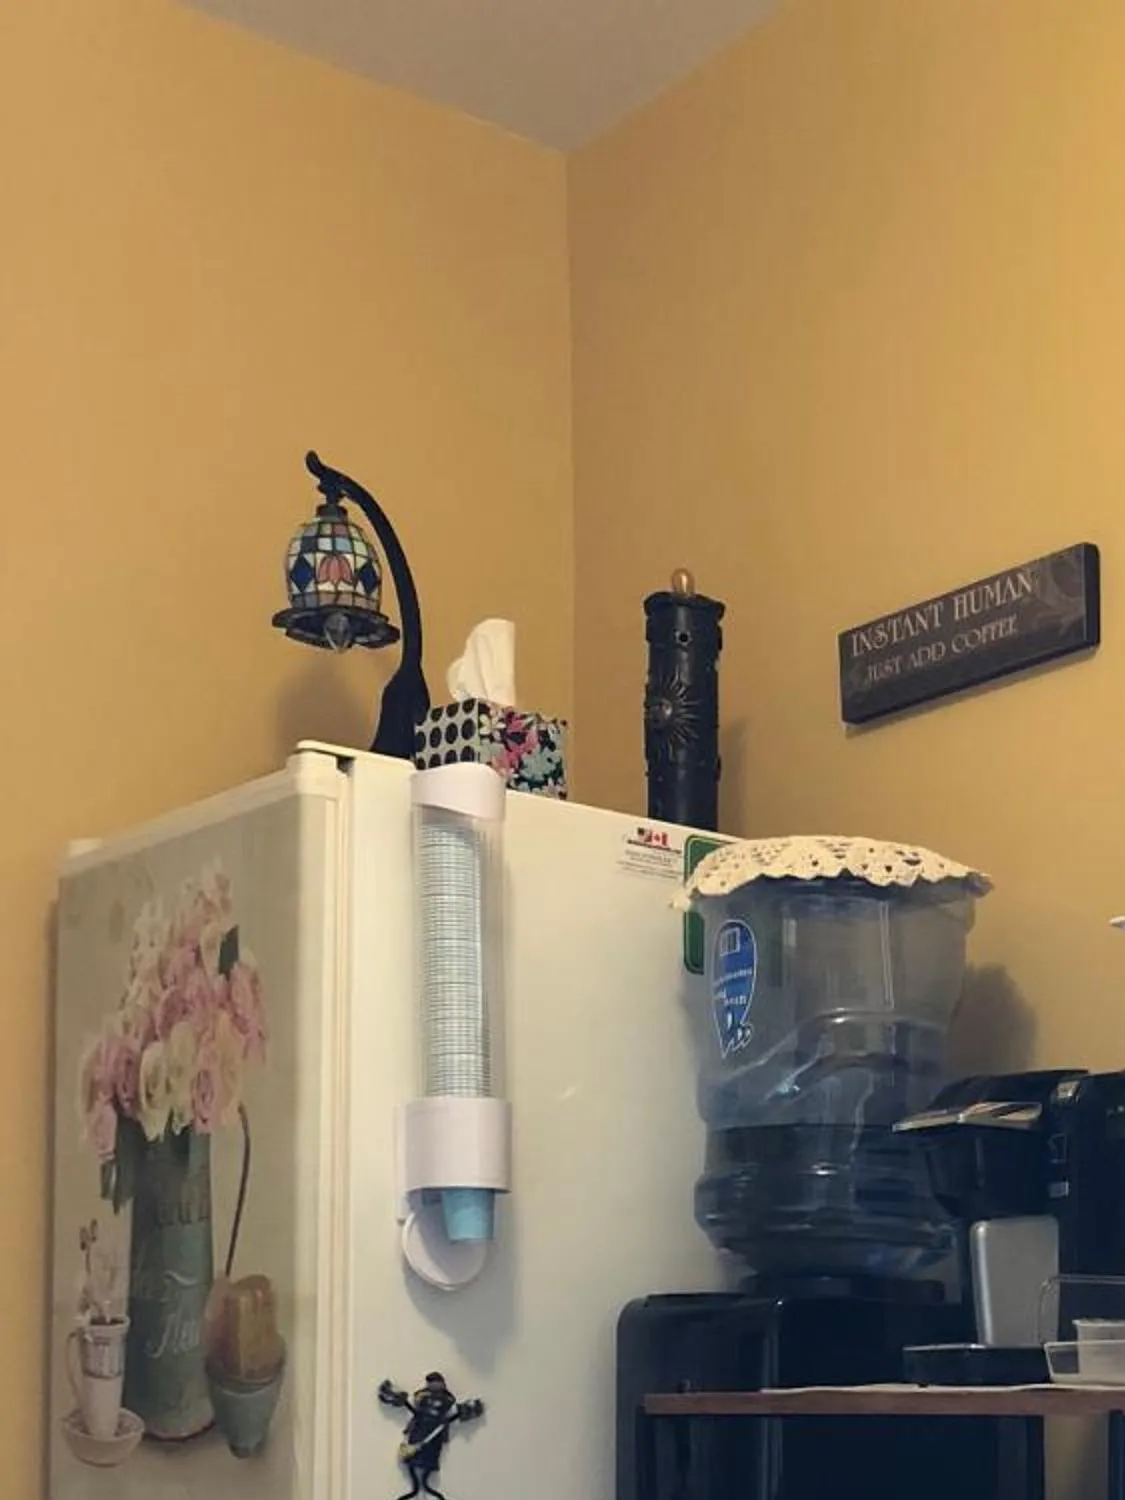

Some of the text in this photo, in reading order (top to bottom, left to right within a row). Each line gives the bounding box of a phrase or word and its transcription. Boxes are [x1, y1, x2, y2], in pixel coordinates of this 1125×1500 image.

[852, 569, 1034, 658] INSTANT HUMAN
[866, 614, 1017, 684] JUST ADD COFFEE
